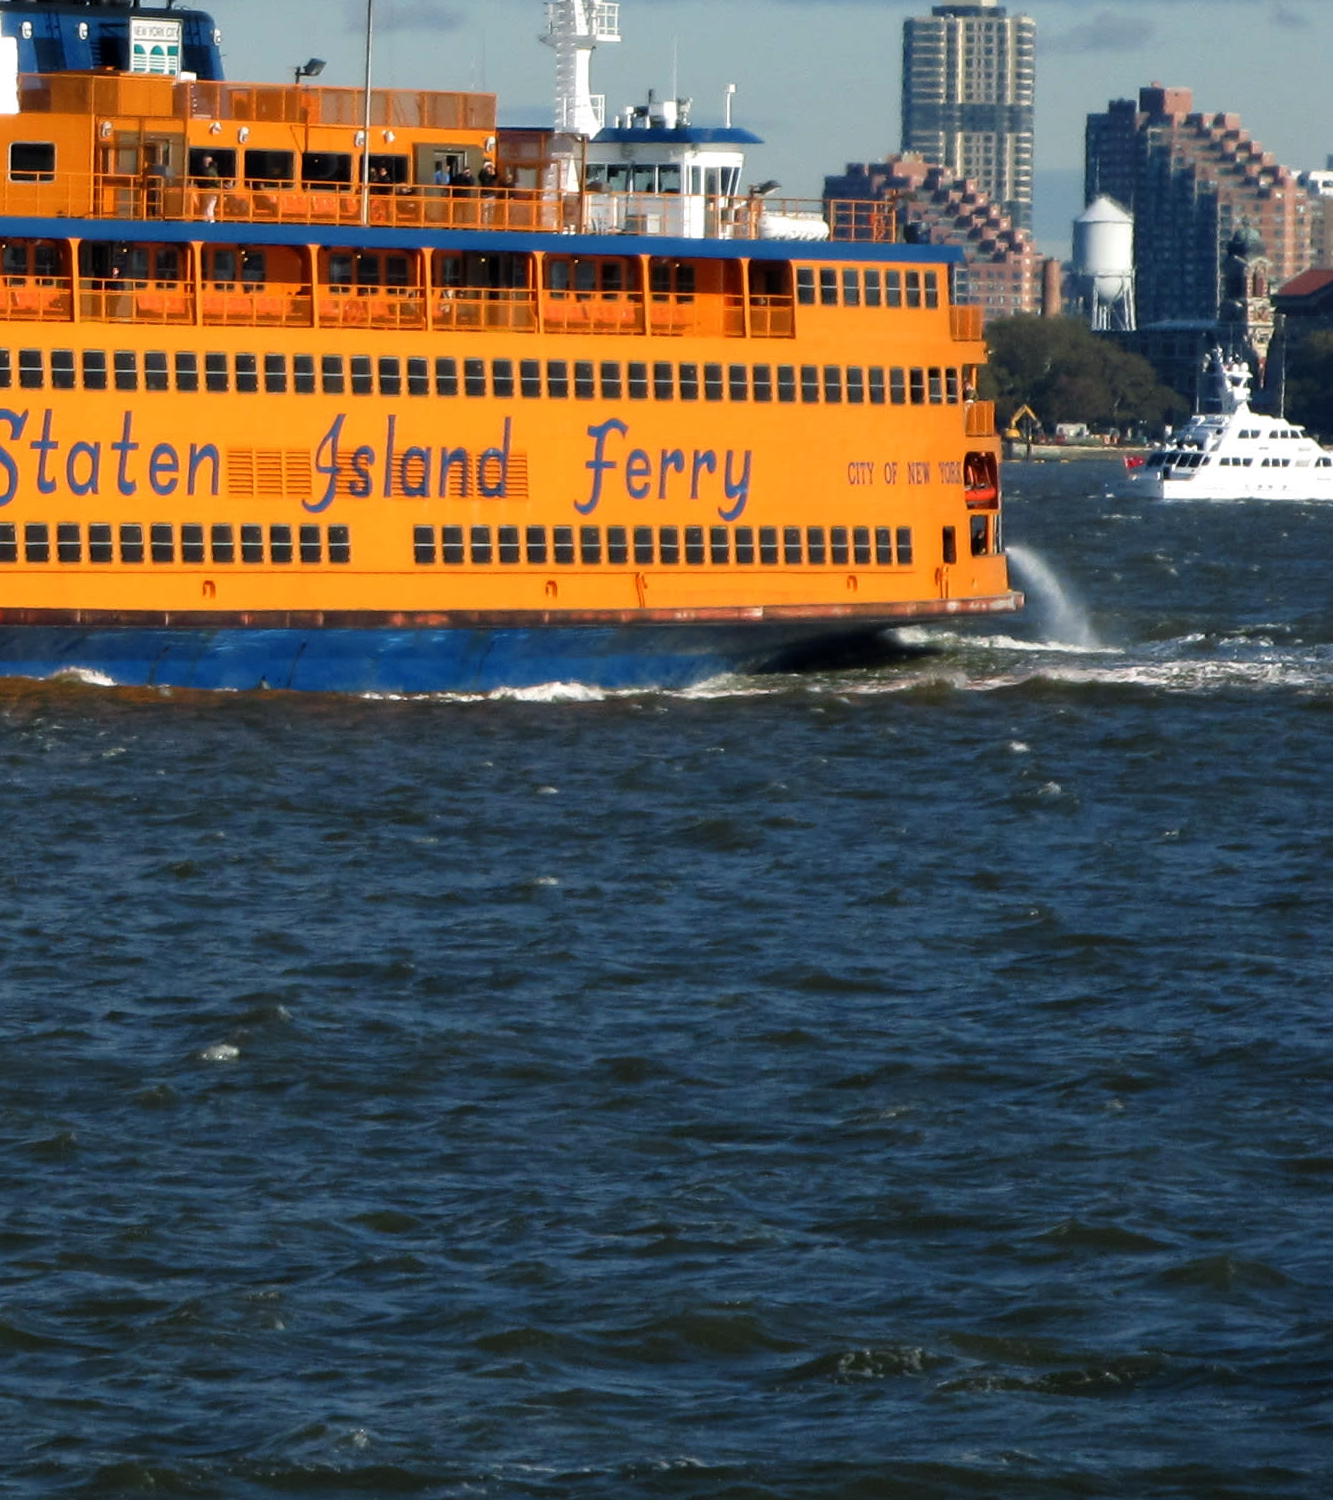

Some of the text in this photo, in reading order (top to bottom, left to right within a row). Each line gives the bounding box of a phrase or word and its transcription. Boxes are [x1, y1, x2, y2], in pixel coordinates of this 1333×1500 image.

[301, 413, 512, 513] Island
[573, 417, 752, 522] Ferry
[848, 462, 962, 484] CITY OF NEW YORK
